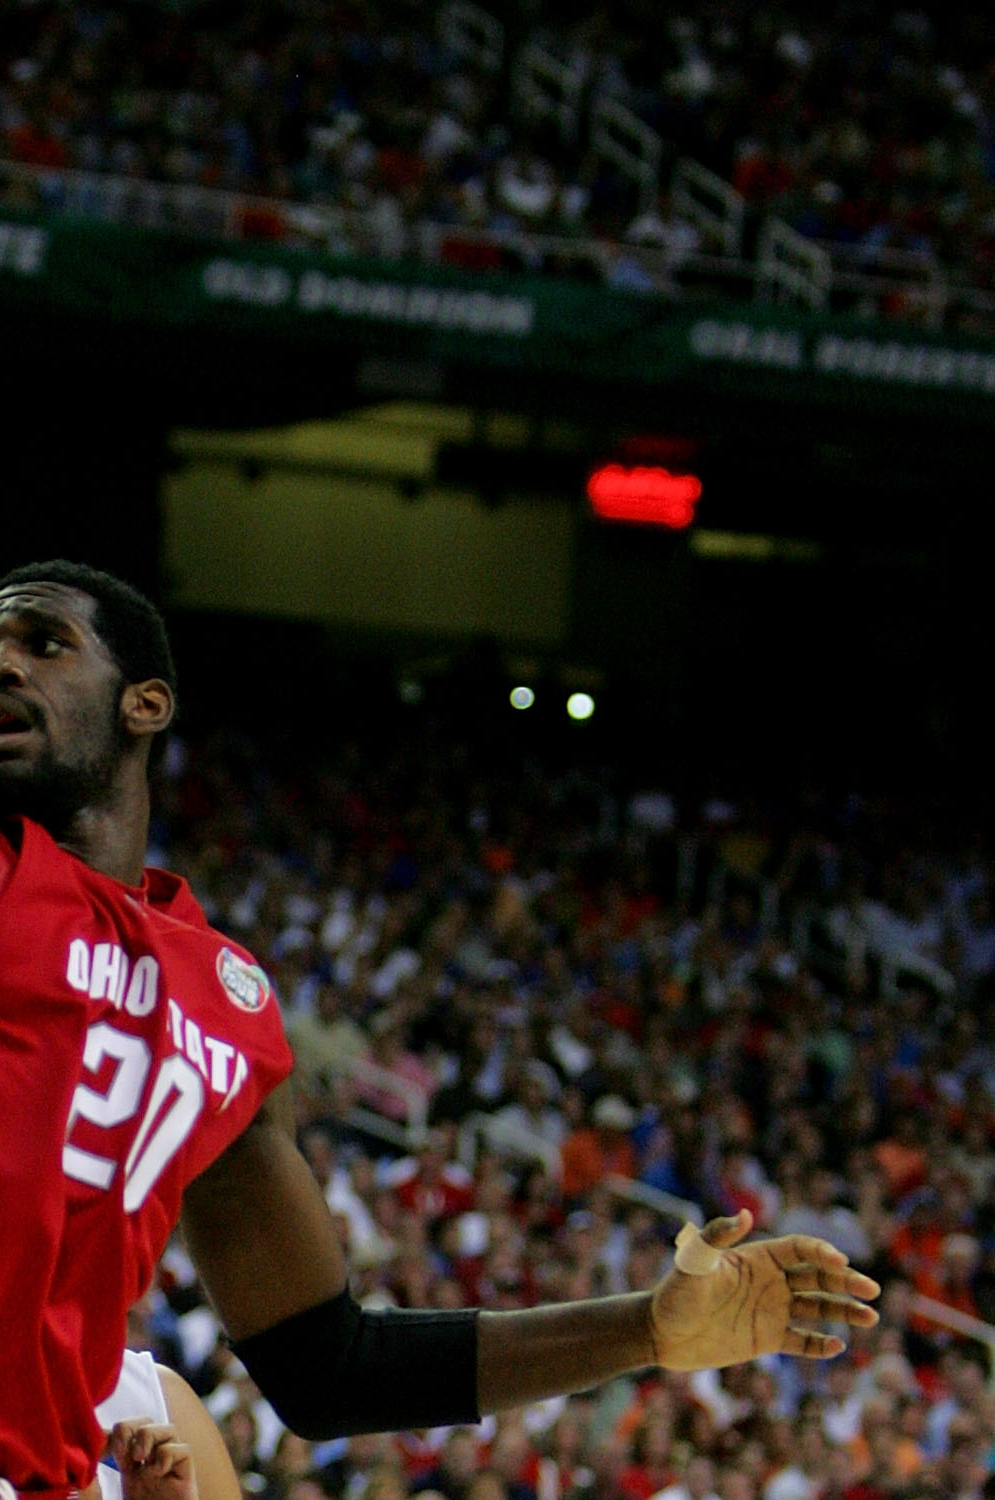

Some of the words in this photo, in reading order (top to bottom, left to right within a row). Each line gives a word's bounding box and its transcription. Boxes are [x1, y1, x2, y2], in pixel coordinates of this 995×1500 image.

[206, 259, 291, 304] OLD
[66, 937, 160, 1017] OHIO
[61, 1020, 205, 1214] 20
